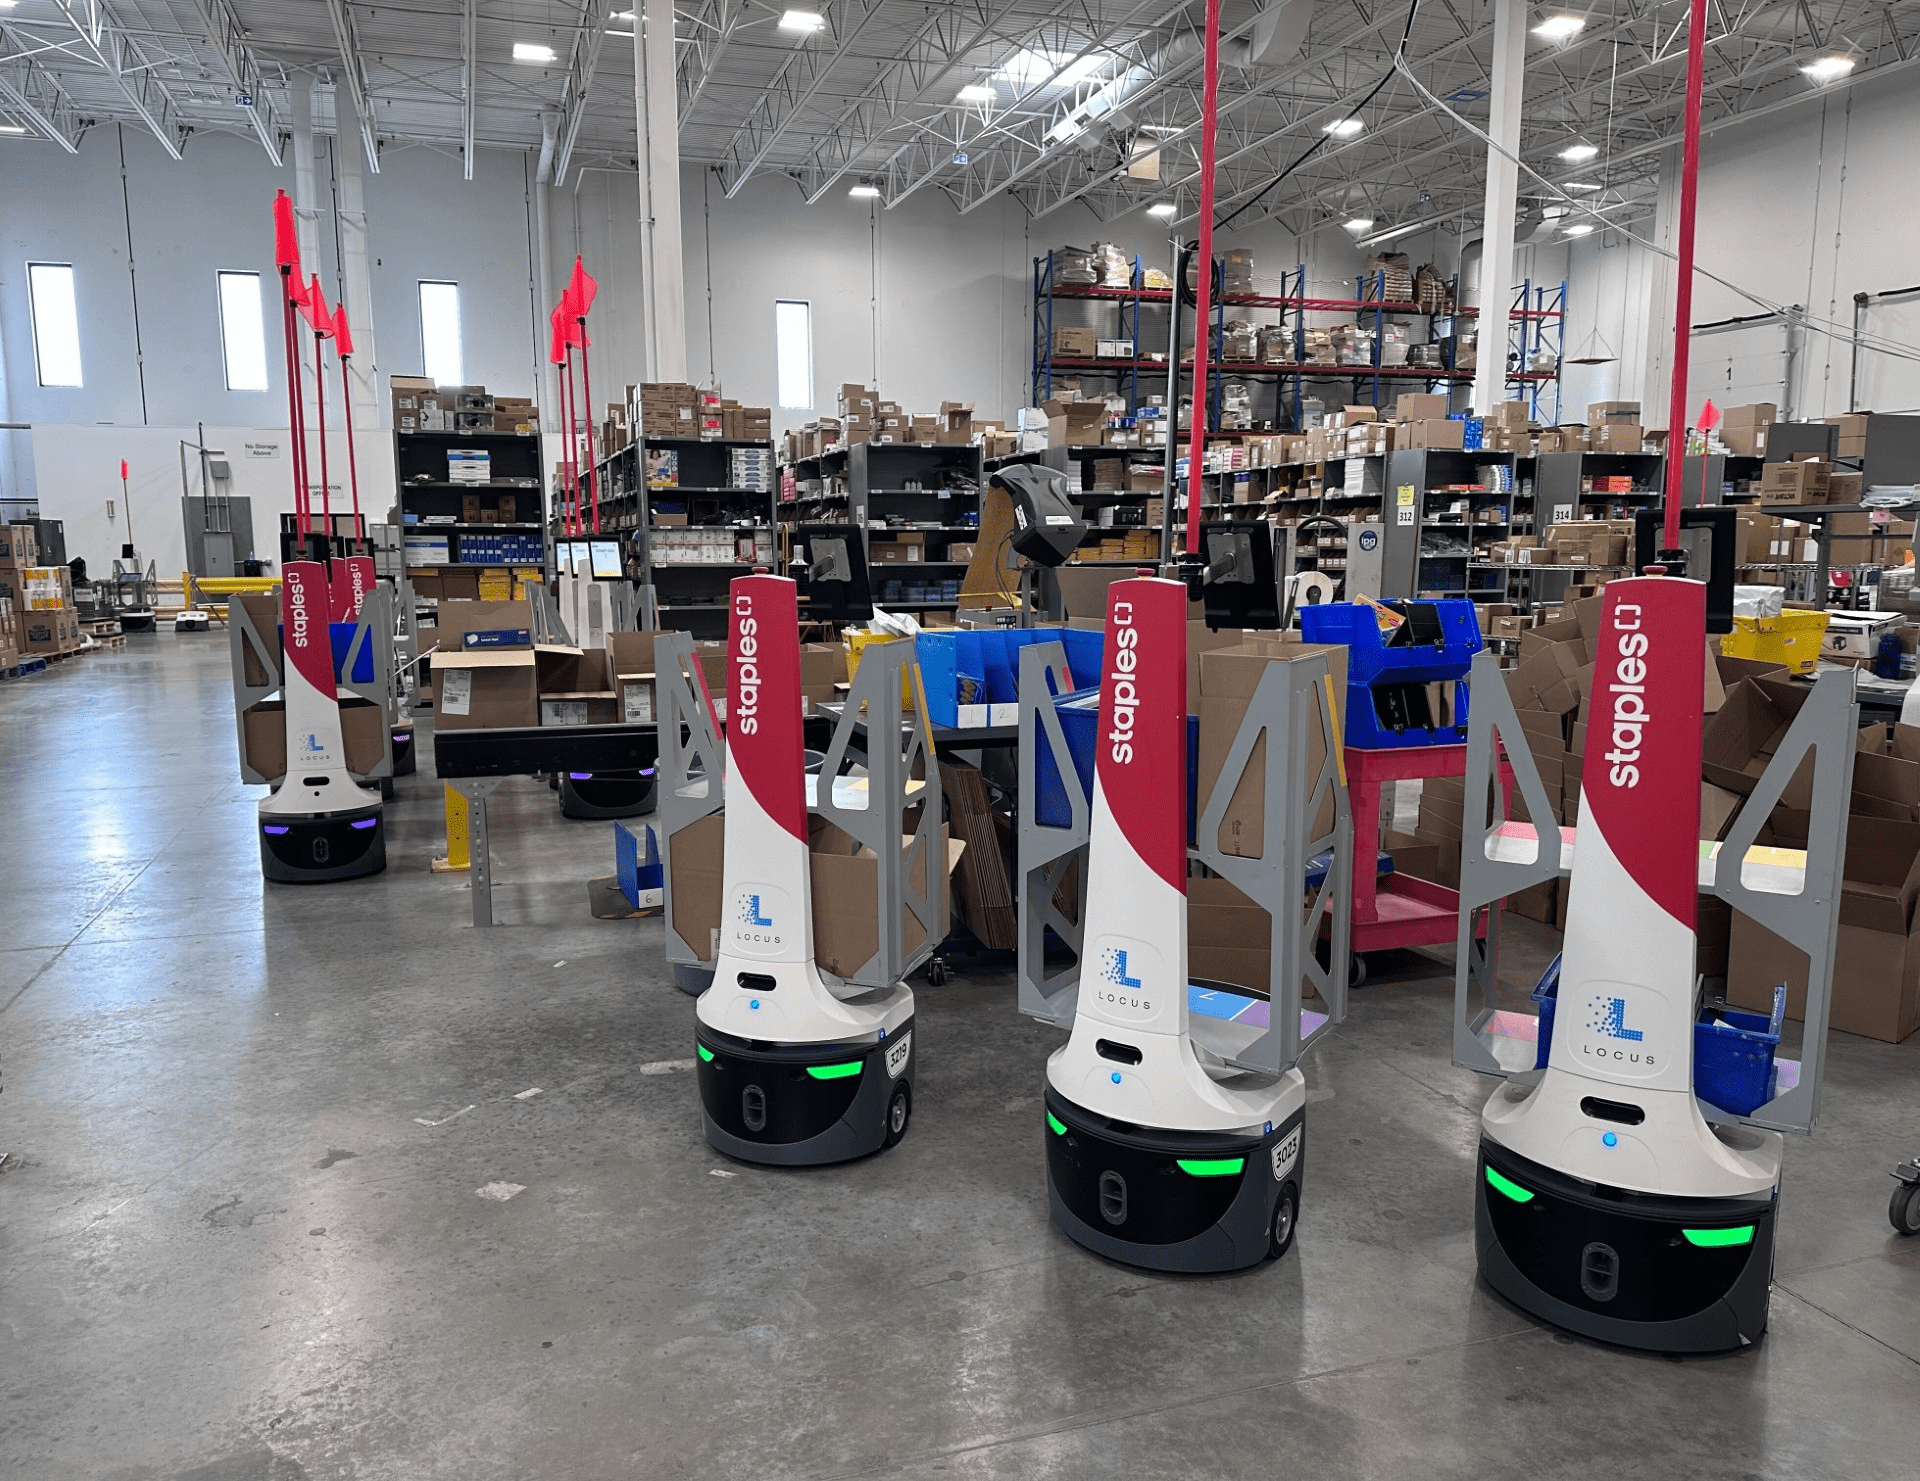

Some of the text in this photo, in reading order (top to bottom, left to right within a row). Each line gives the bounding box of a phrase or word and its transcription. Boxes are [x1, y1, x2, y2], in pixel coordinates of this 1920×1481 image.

[1399, 511, 1413, 522] 312
[1554, 510, 1570, 520] 314
[290, 583, 309, 648] staples
[736, 617, 762, 736] staples
[1108, 627, 1140, 765] staples
[998, 708, 1009, 719] 2
[1604, 632, 1650, 789] staples
[645, 893, 653, 904] 6
[736, 932, 781, 944] LOCUS
[1098, 991, 1151, 1010] LOCUS
[890, 1042, 907, 1068] 3219
[1583, 1044, 1655, 1065] LOCUS
[1276, 1135, 1297, 1169] 3023
